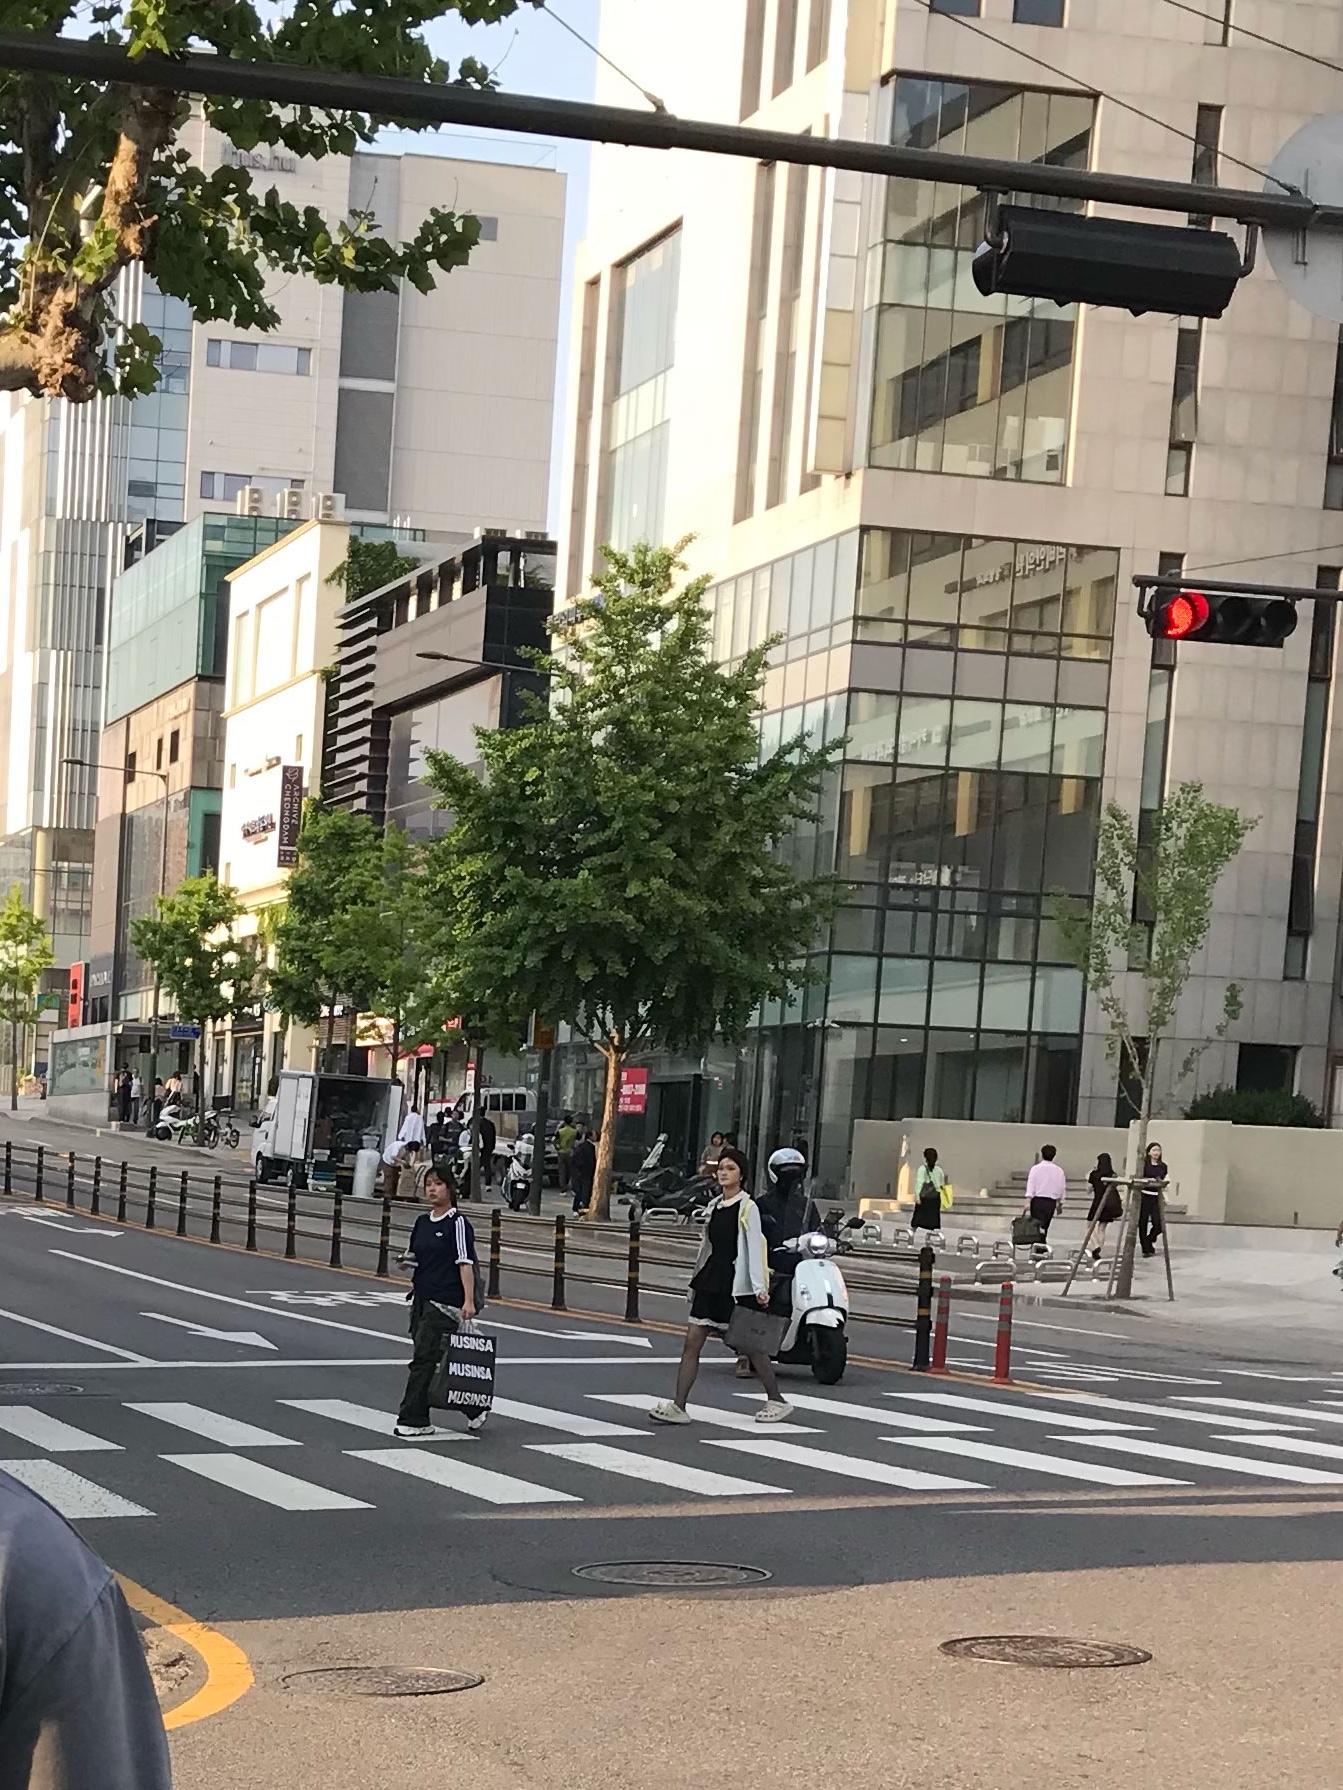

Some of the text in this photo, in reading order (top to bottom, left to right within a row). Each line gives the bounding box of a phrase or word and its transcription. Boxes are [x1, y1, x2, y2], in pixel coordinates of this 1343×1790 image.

[290, 784, 300, 825] ARCHIVE
[450, 1333, 494, 1353] MUSINSA
[448, 1361, 493, 1381] MUSINSA
[447, 1389, 492, 1408] MUSINSA
